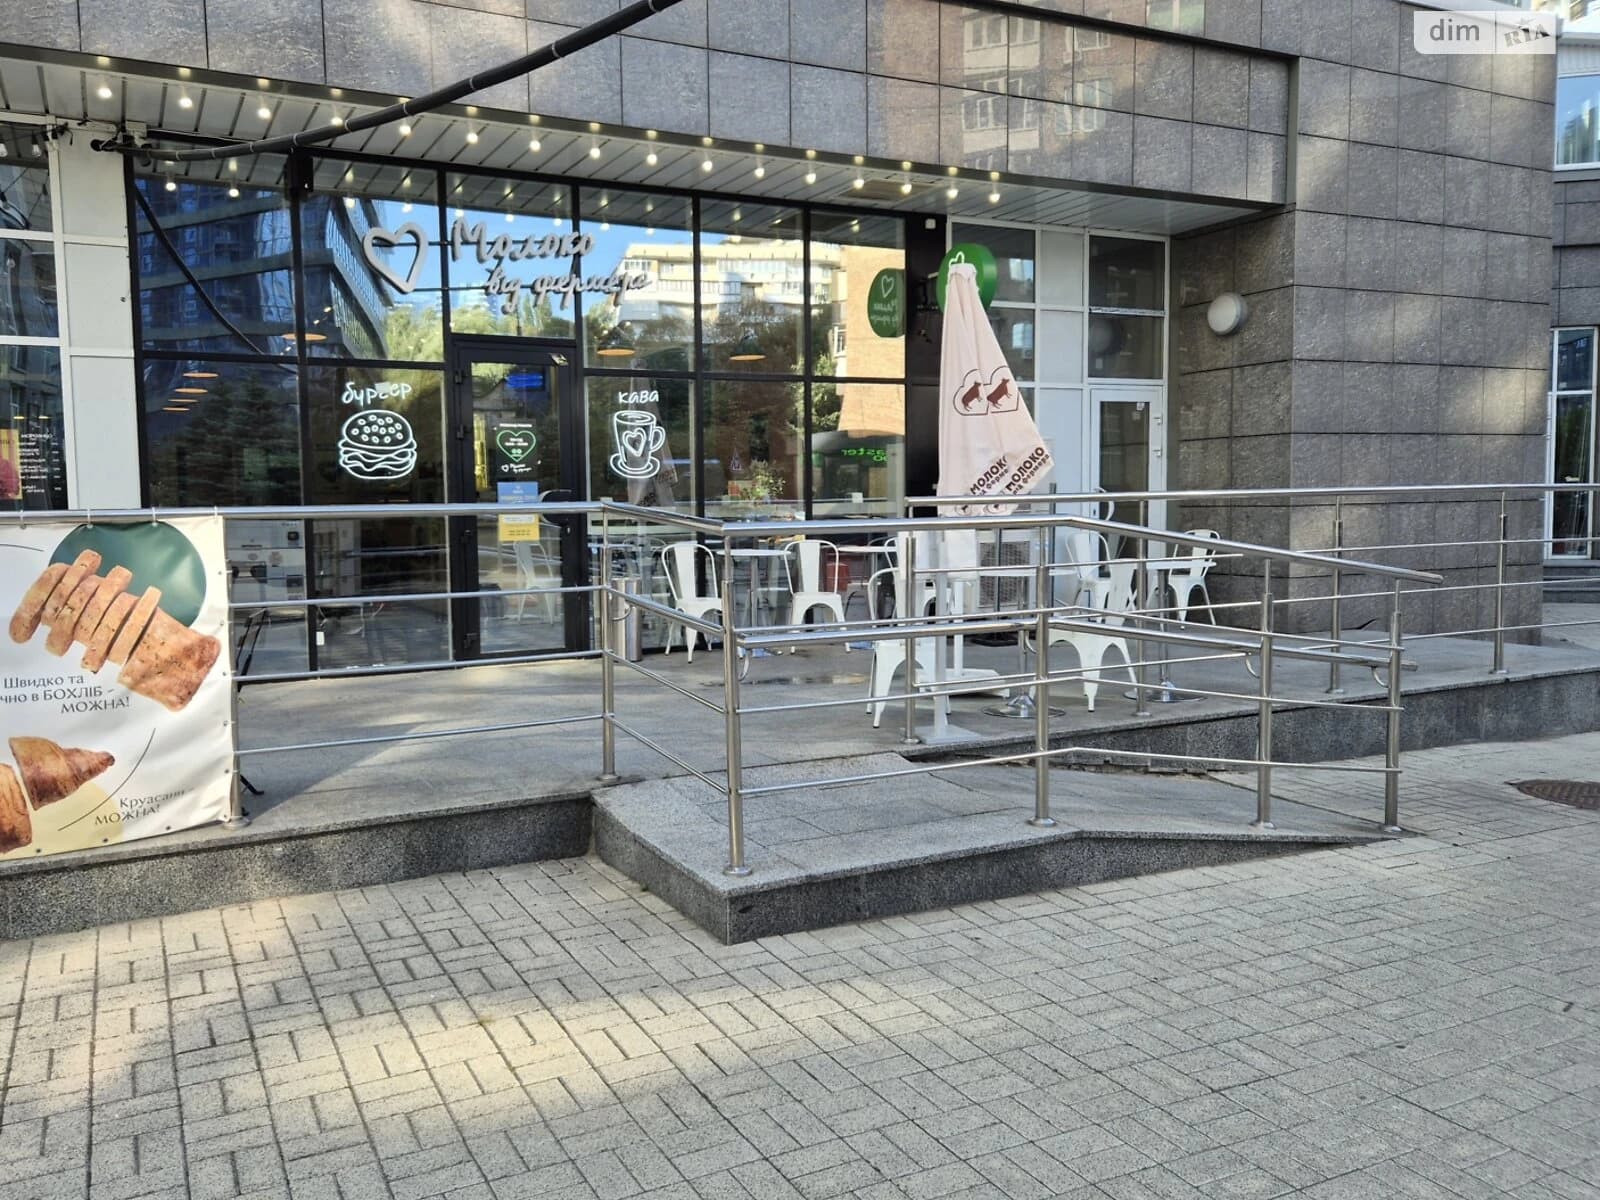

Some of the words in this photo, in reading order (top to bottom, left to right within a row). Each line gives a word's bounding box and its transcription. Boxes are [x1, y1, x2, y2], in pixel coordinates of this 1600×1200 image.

[452, 216, 596, 264] Молоко
[618, 390, 660, 404] кава
[1005, 447, 1045, 491] МОЛОКО
[4, 676, 64, 689] Швидко
[67, 675, 84, 684] та
[43, 686, 103, 700] БОХЛІБ
[61, 696, 130, 714] МОЖНА!
[94, 803, 161, 826] МОЖНА!
